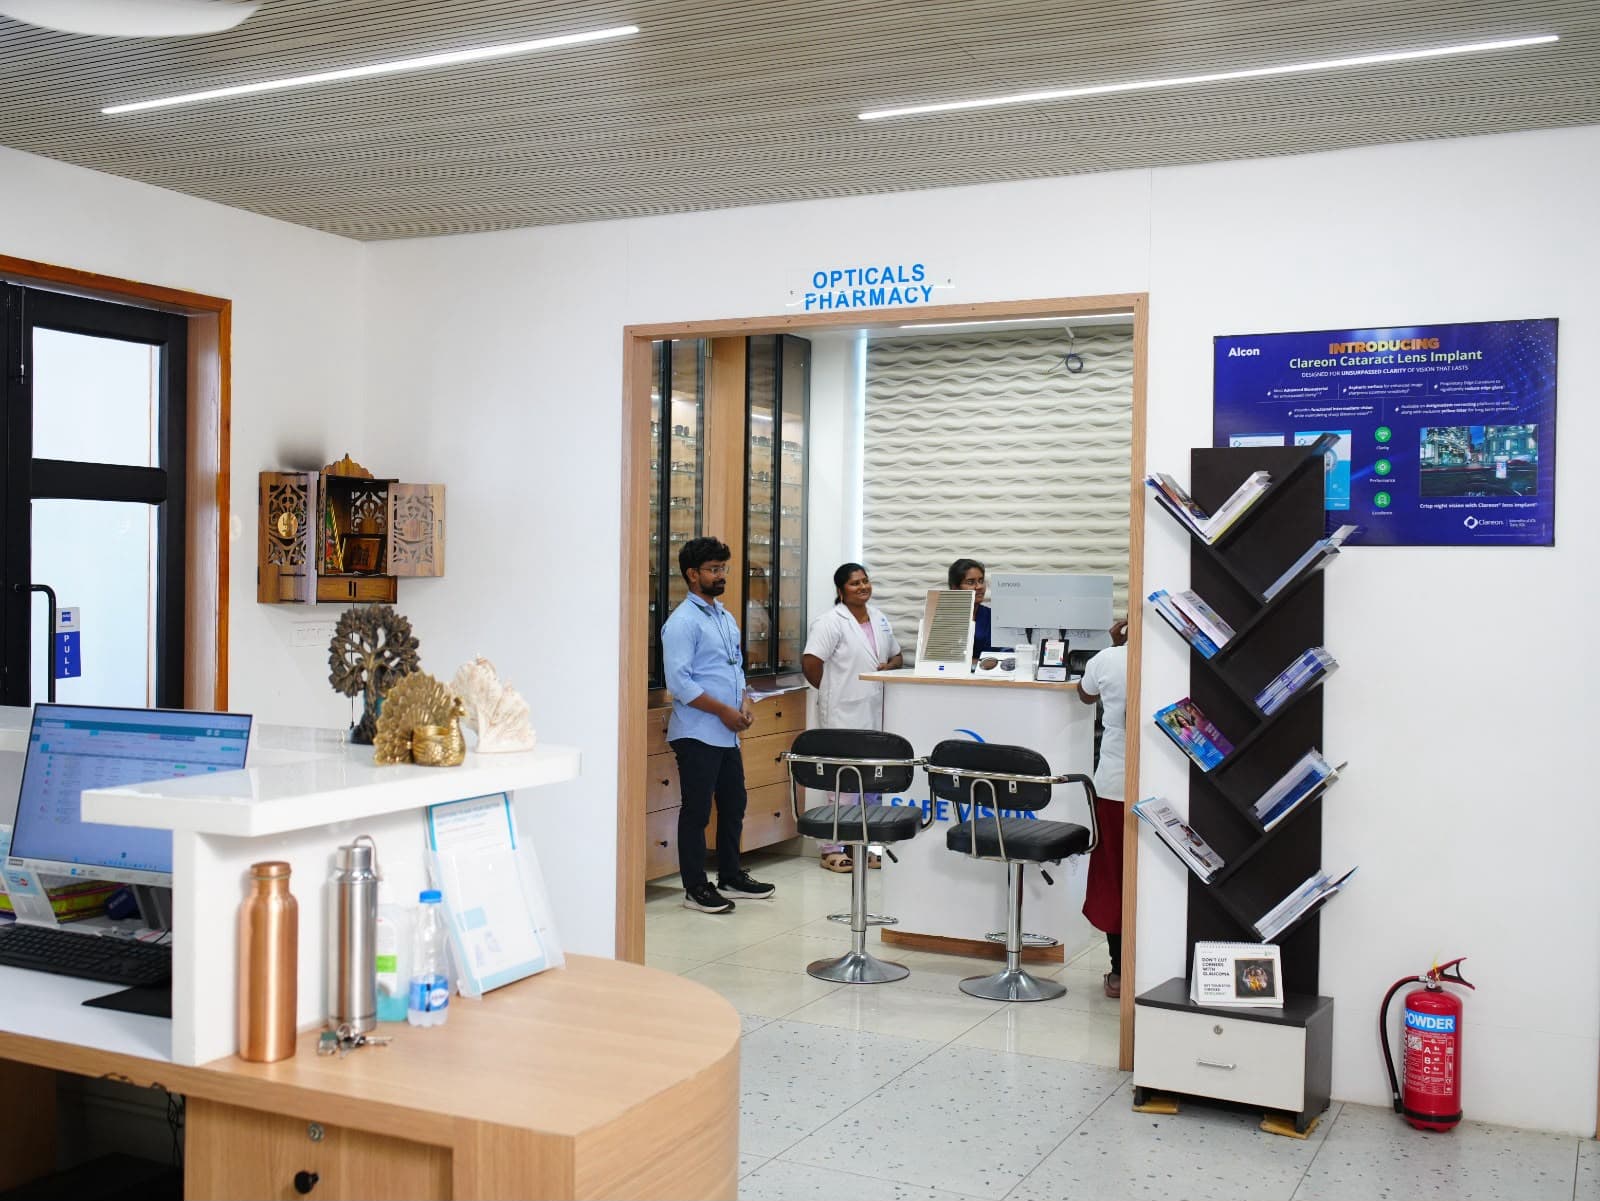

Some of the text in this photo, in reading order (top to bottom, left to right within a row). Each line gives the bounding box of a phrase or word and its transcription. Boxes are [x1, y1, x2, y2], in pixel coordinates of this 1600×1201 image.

[813, 263, 926, 289] OPTICALS
[804, 285, 934, 311] PHARMACY
[1228, 346, 1261, 358] Alcon
[1329, 338, 1440, 354] INTRODUCING
[1289, 350, 1483, 369] Clareon Cataract Lens Implant
[1341, 369, 1382, 377] UNSURPASSED
[1383, 367, 1407, 375] CLARITY
[1407, 366, 1416, 374] OF
[1416, 366, 1435, 374] VISION
[1436, 365, 1451, 373] THAT
[1451, 364, 1469, 372] LASTS
[1405, 1011, 1454, 1030] POWDER
[1423, 1046, 1432, 1055] A
[1424, 1056, 1431, 1064] B
[1423, 1066, 1431, 1074] C
